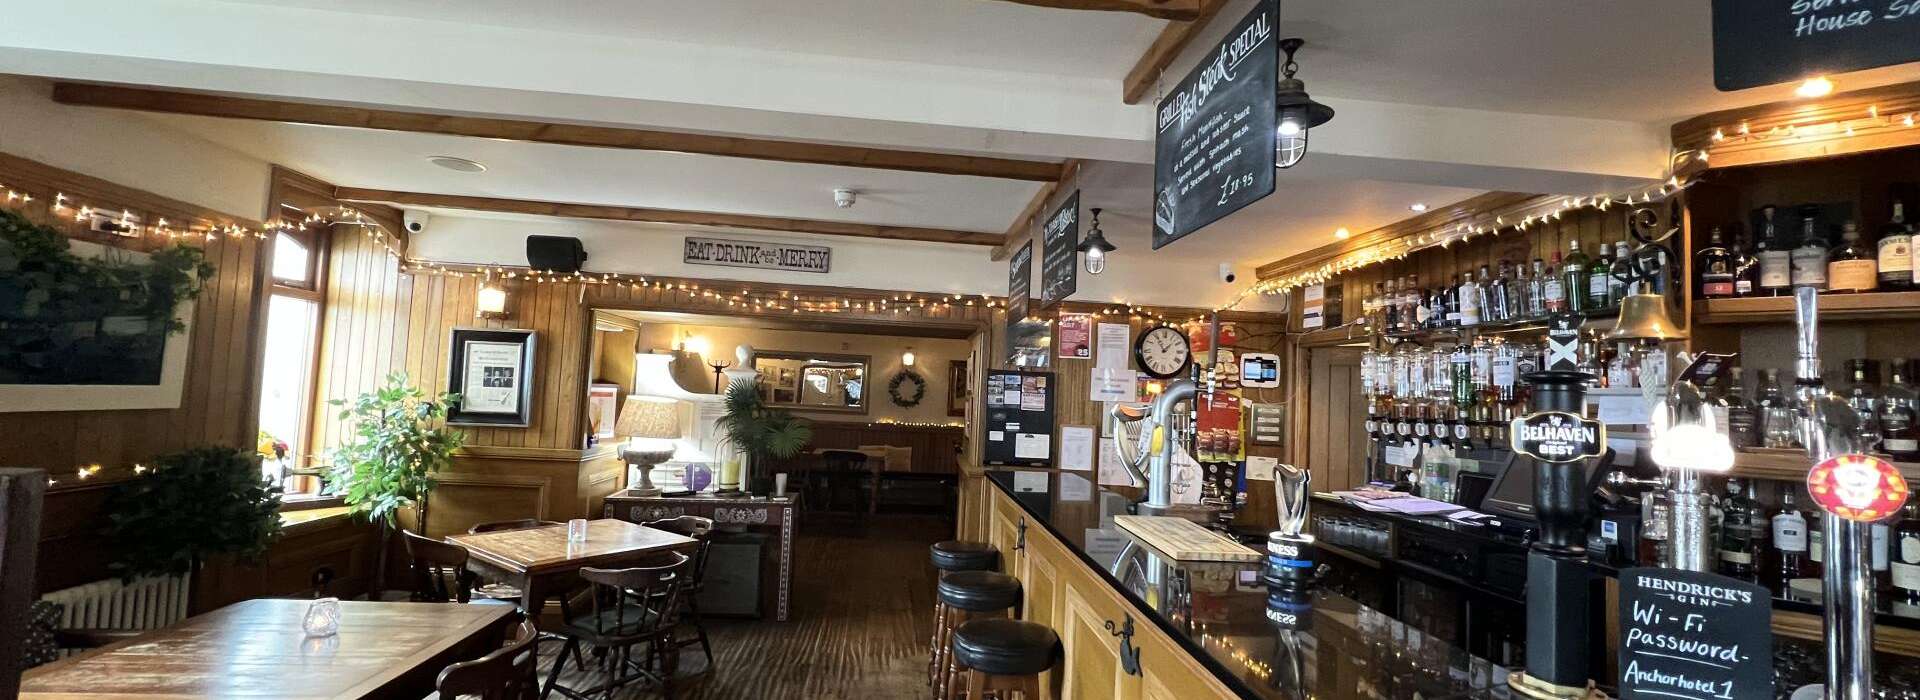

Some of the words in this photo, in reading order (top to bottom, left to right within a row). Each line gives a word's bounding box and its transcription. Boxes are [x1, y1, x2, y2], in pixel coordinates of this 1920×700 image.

[1794, 10, 1873, 37] House
[1159, 91, 1186, 129] GRILLED
[1179, 83, 1198, 131] Fish
[1199, 43, 1237, 106] Steak
[1229, 12, 1271, 67] SPECIAL
[715, 243, 760, 265] DRINK
[778, 248, 828, 269] MERRY
[1520, 424, 1595, 444] BELHAVEN
[1538, 444, 1575, 455] BEST
[1637, 576, 1753, 604] HENDRICK'S
[1677, 594, 1710, 607] GIN
